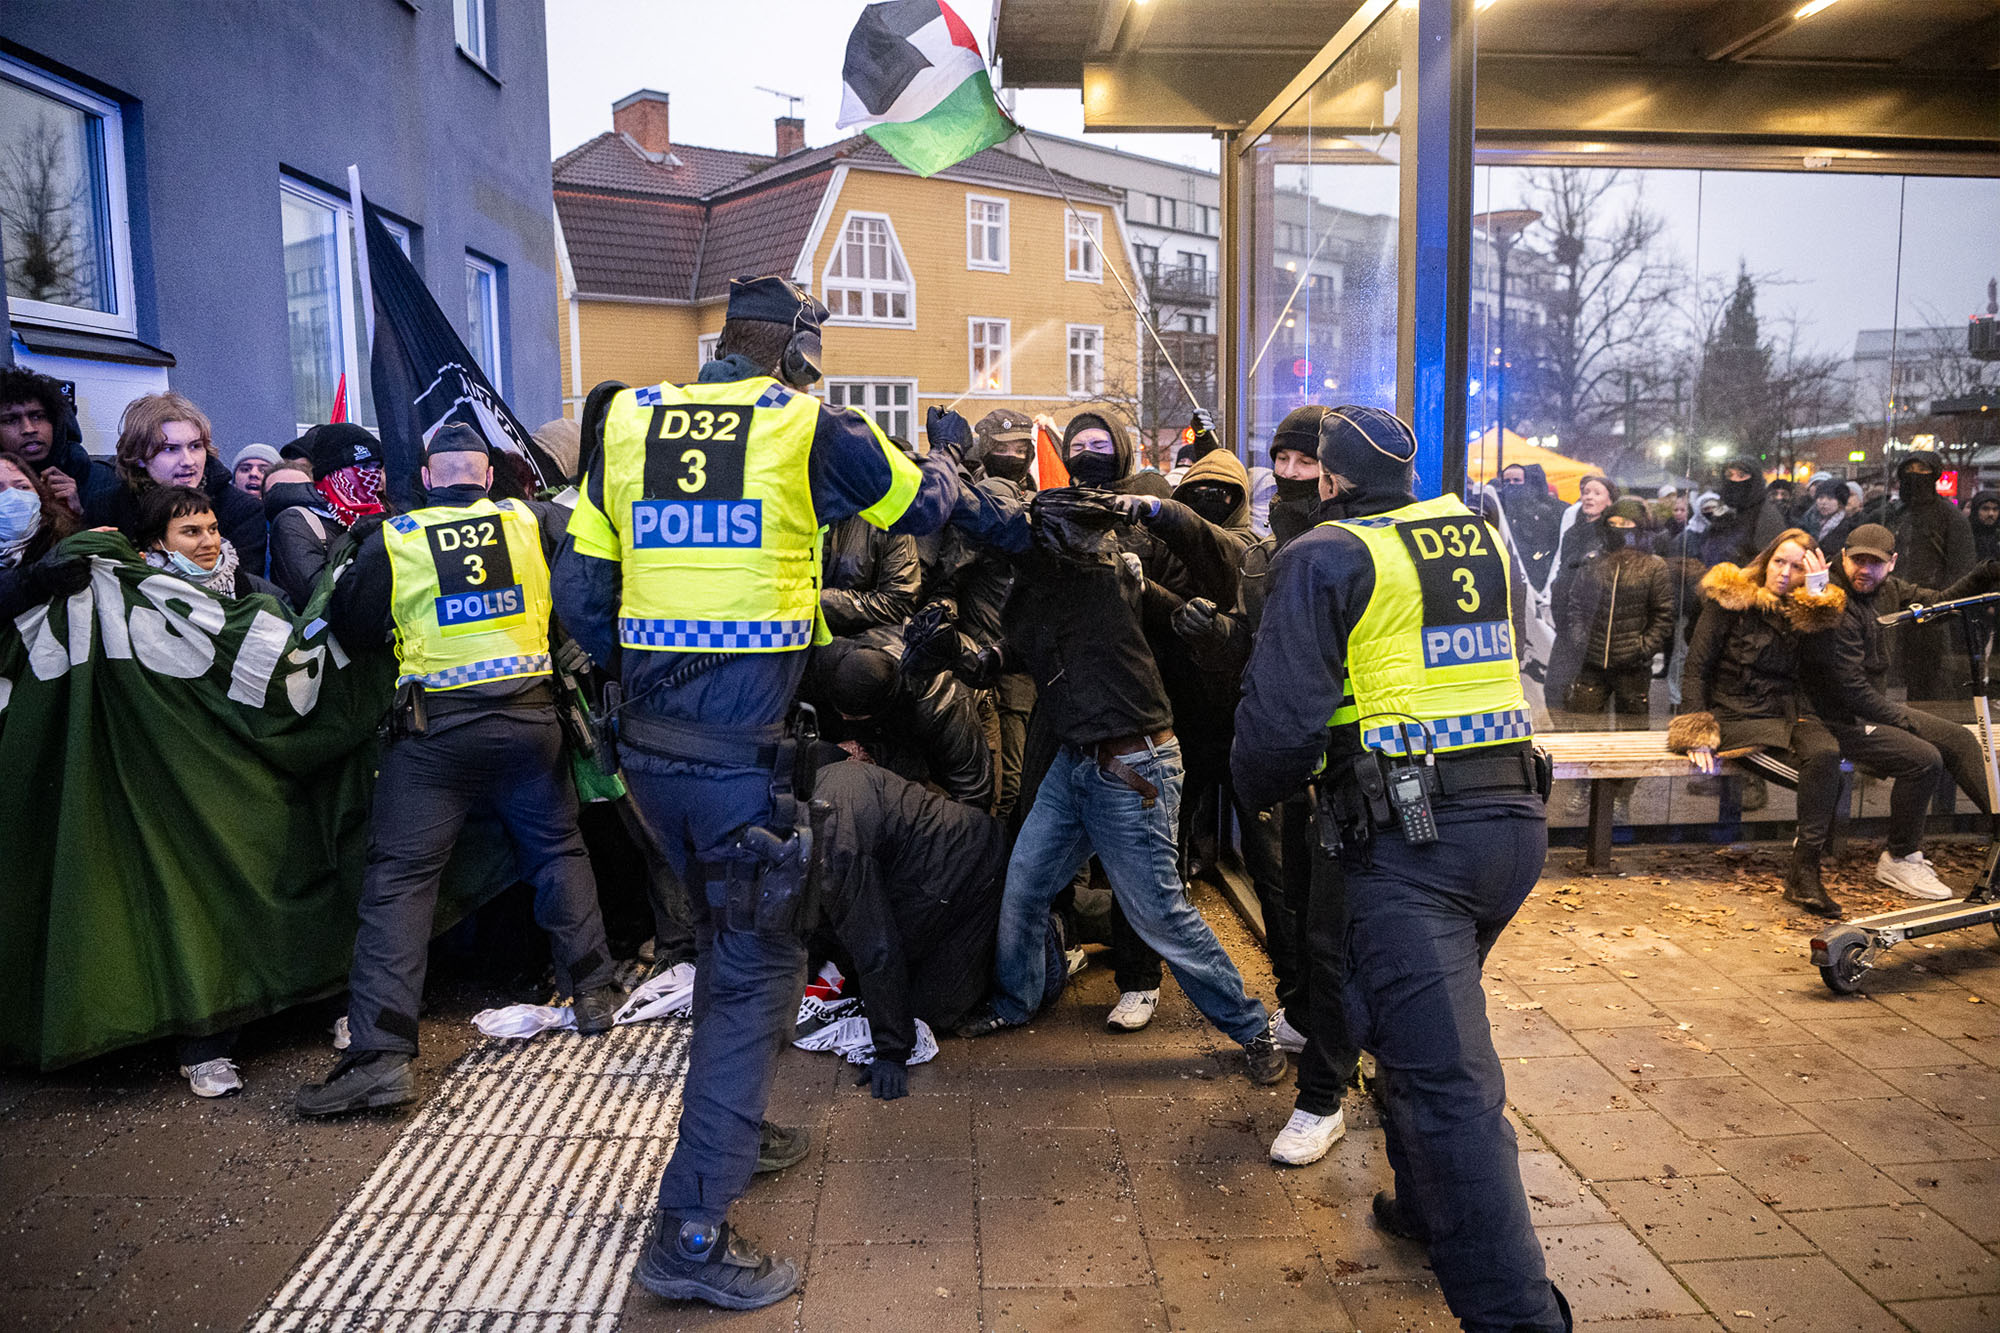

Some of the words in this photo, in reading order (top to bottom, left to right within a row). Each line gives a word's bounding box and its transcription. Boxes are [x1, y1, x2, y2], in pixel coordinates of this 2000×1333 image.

[658, 409, 741, 441] D32
[676, 449, 707, 493] 3
[436, 522, 498, 552] D32
[634, 504, 758, 545] POLIS
[1411, 523, 1488, 560] D32
[463, 554, 487, 585] 3
[445, 590, 518, 620] POLIS
[1452, 567, 1480, 613] 3
[1426, 623, 1511, 664] POLIS
